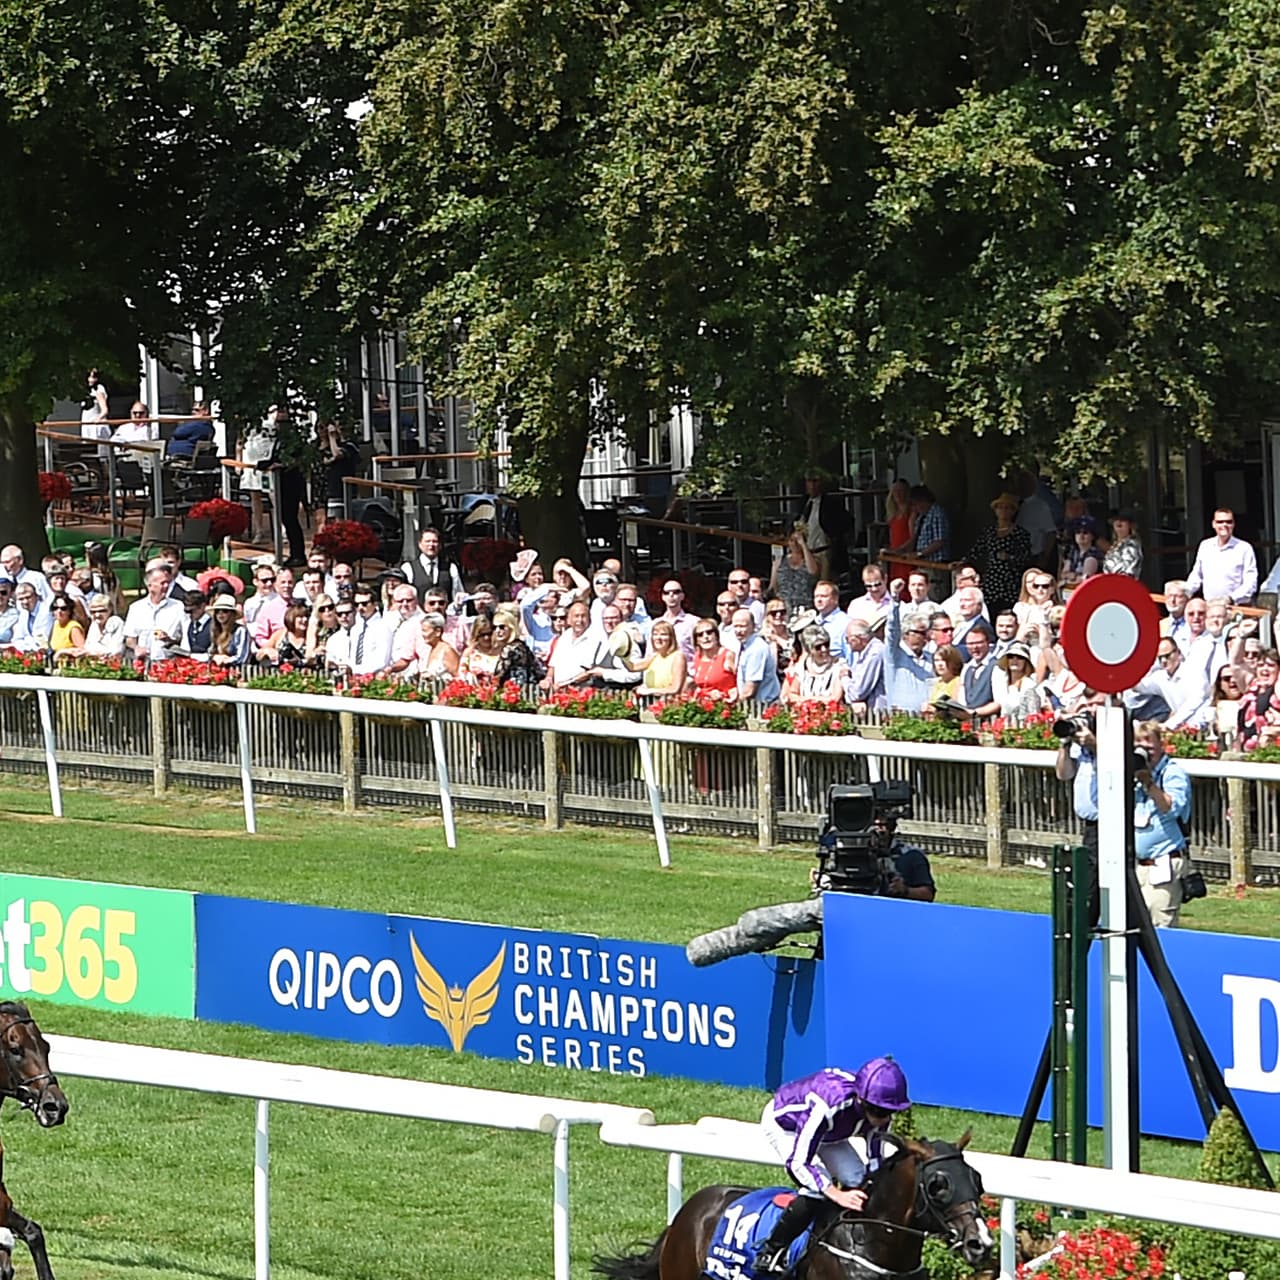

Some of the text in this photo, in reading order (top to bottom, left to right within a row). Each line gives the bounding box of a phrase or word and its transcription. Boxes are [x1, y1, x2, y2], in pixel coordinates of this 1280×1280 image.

[268, 947, 403, 1018] QIPCO
[513, 941, 658, 989] BRITISH
[514, 984, 737, 1049] CHAMPIONS
[516, 1034, 647, 1078] SERIES
[722, 1204, 760, 1250] 14
